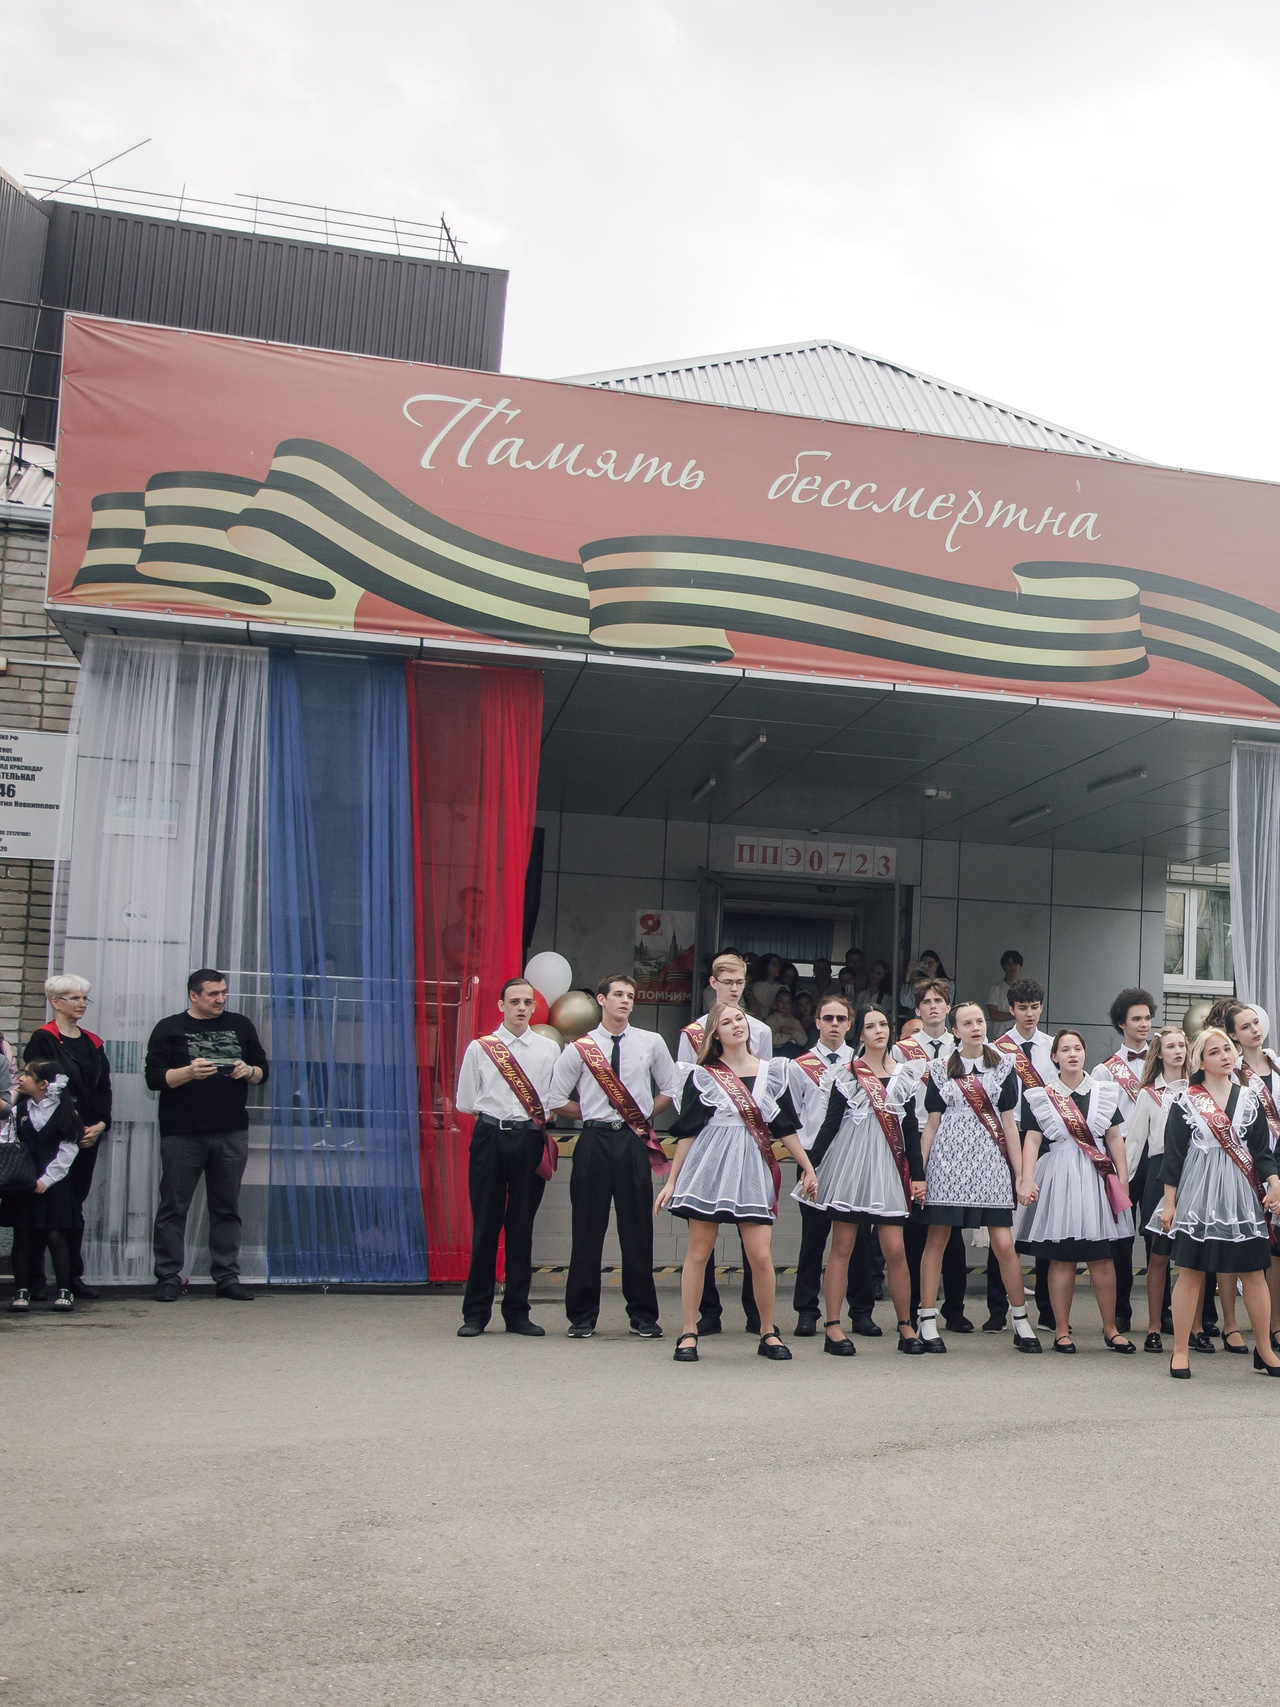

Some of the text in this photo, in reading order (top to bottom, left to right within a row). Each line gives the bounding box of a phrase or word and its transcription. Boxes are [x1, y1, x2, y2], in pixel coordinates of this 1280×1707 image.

[402, 393, 1102, 553] Память бессмертна
[0, 771, 36, 781] ТЕЛЬНАЯ
[0, 783, 16, 798] 46
[10, 764, 43, 772] КРАСНОДАР
[637, 990, 692, 1001] ПОМНИМ
[490, 1043, 534, 1103] Выпускник
[585, 1047, 627, 1105] Выпускник
[711, 1067, 757, 1127] Выпускница
[863, 1075, 898, 1142] Выпукница
